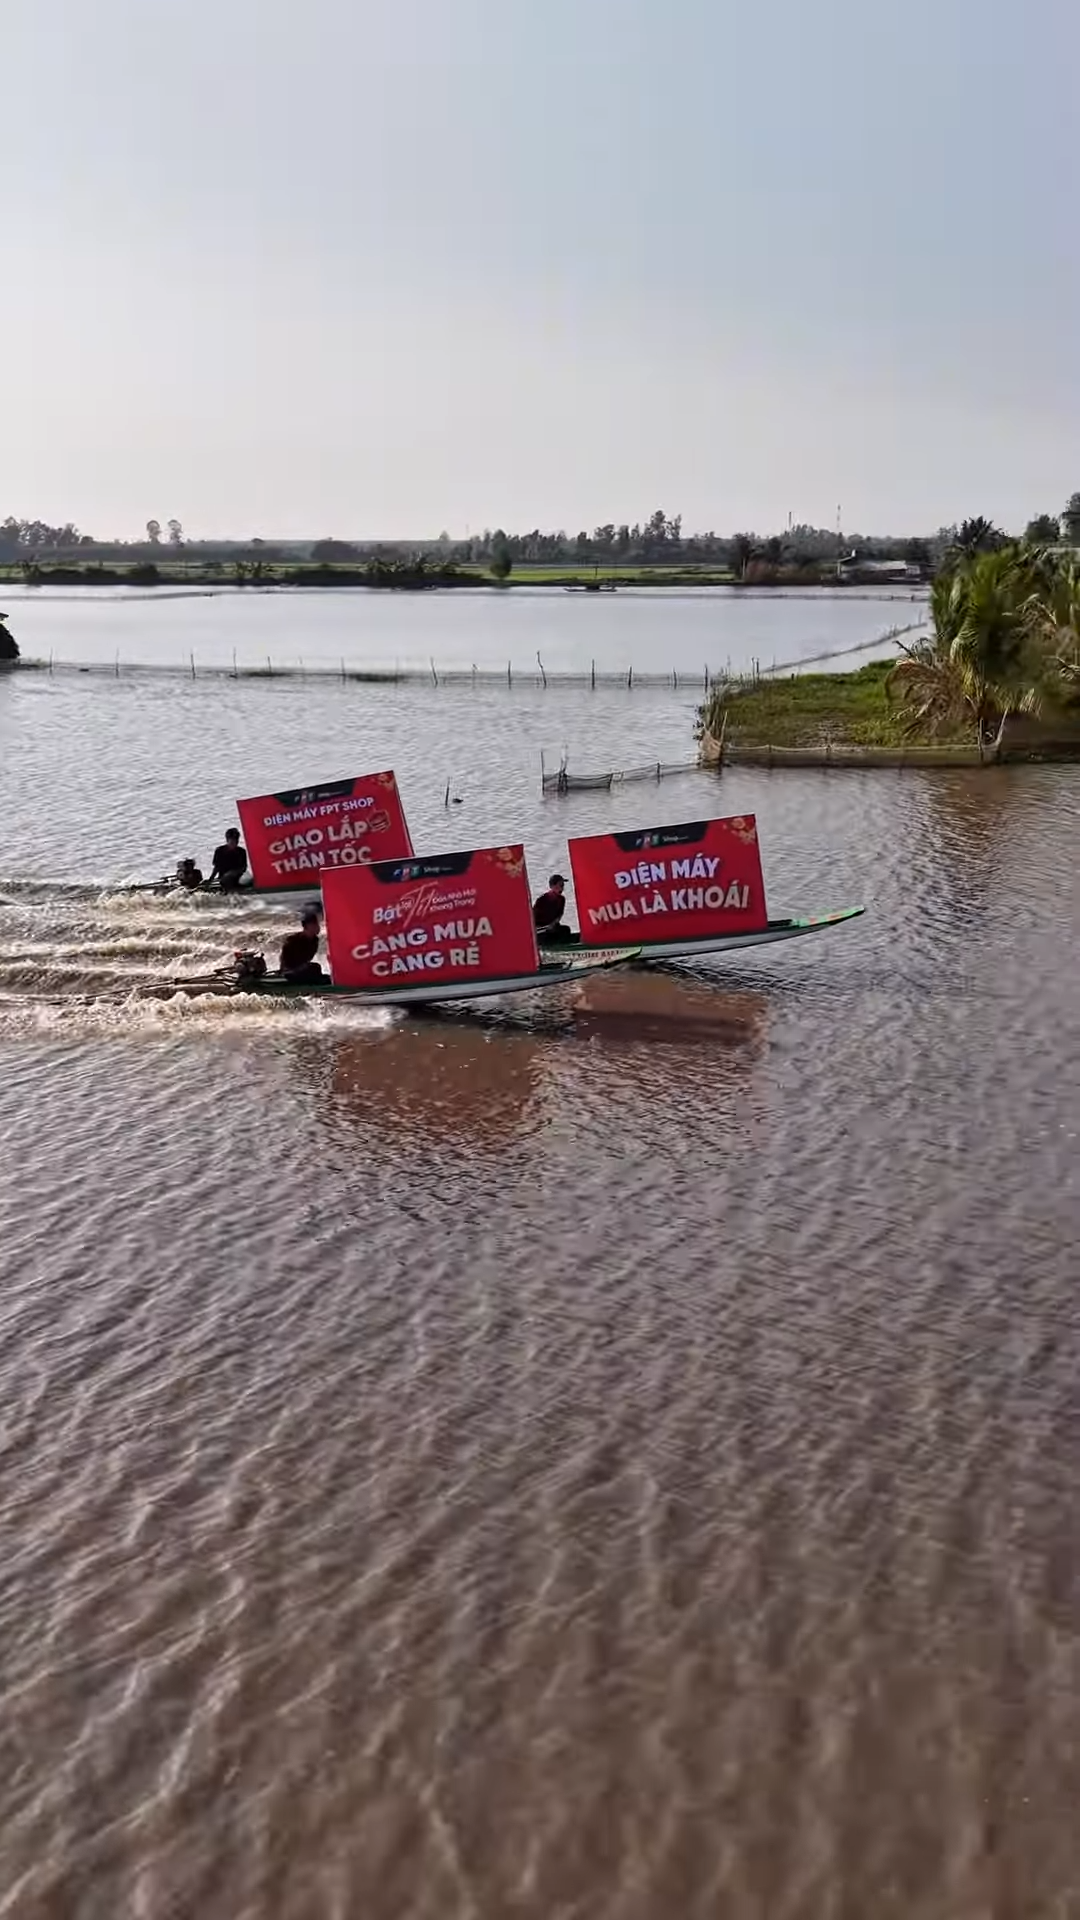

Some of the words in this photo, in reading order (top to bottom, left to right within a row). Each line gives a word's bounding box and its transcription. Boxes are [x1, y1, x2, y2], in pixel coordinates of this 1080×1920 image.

[264, 811, 291, 827] ĐIỆN
[293, 806, 317, 821] MÁY
[320, 804, 340, 816] FPT
[342, 797, 374, 811] SHOP
[269, 829, 323, 855] GIAO
[327, 815, 368, 842] LẮP
[272, 847, 325, 874] THẦN
[328, 840, 372, 864] TỐC
[393, 865, 420, 881] FPT
[614, 861, 666, 890] ĐIỆN
[672, 853, 720, 879] MÁY
[373, 905, 402, 924] Bật
[588, 900, 637, 925] MUA
[640, 890, 668, 914] LÀ
[670, 880, 750, 911] KHOÁI
[351, 928, 428, 960] CÀNG
[434, 917, 493, 942] MUA
[372, 950, 444, 976] CÀNG
[450, 941, 480, 967] RẺ
